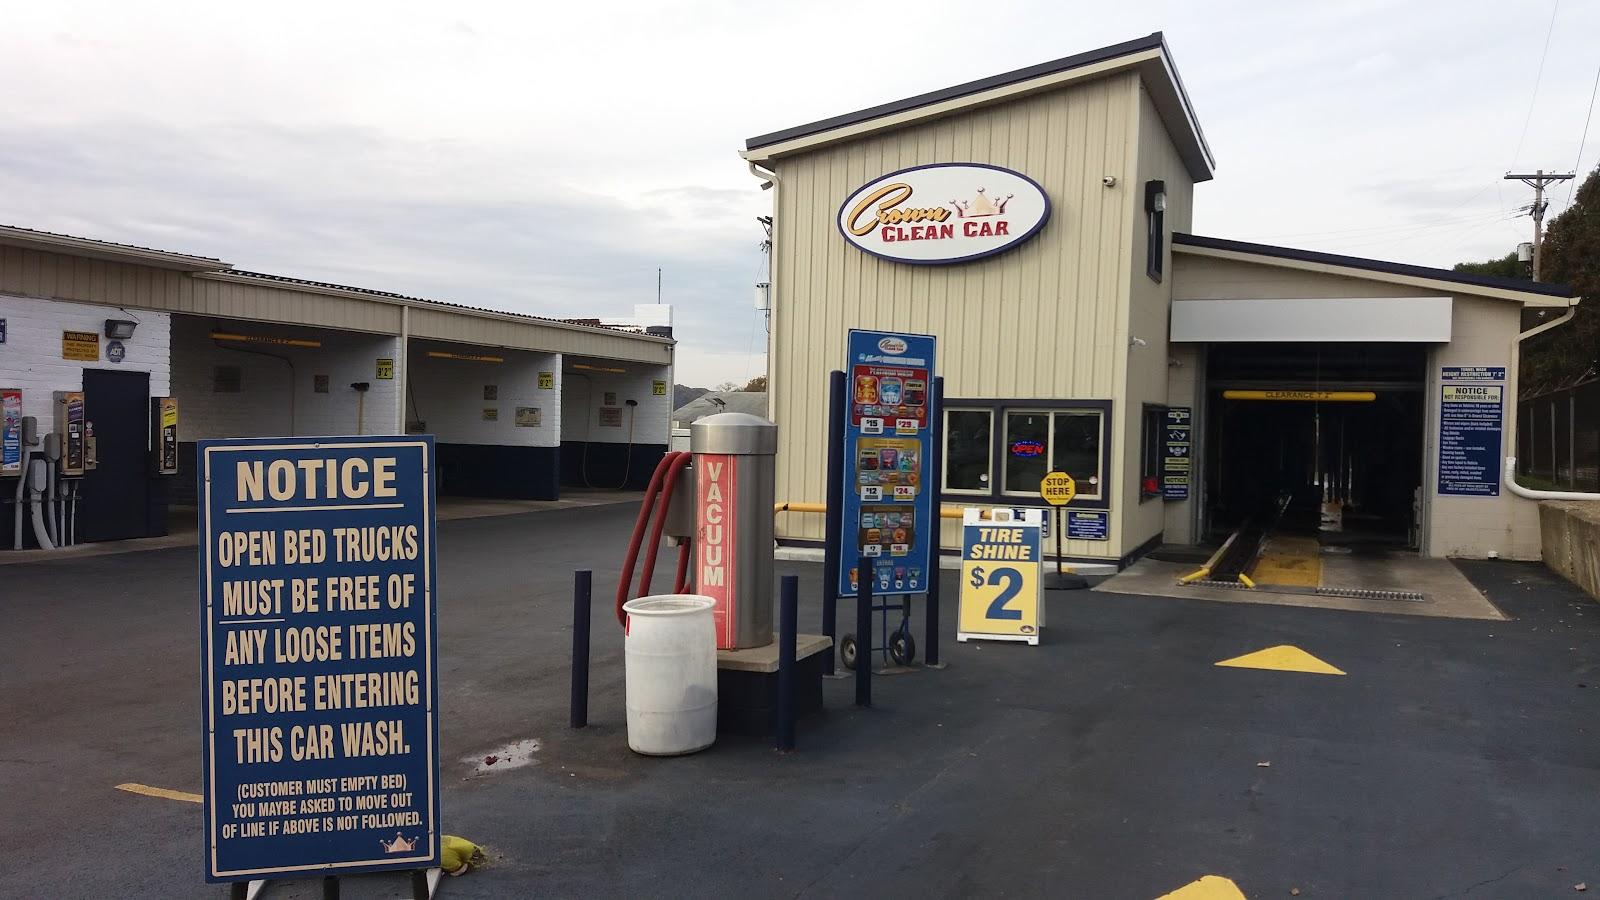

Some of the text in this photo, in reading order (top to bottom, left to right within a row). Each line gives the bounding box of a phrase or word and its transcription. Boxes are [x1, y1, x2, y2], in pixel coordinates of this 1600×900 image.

[847, 182, 952, 237] Crown
[881, 221, 1010, 242] CLEAN CAR
[66, 333, 97, 341] WARNING
[110, 347, 122, 356] ADT
[1265, 391, 1314, 399] CLEARANCE
[1455, 387, 1488, 395] NOTICE
[1011, 444, 1044, 454] OPEN
[237, 457, 397, 502] NOTICE
[1046, 477, 1070, 486] STOP
[1046, 487, 1070, 496] HERE
[703, 462, 724, 587] VACUUM
[979, 528, 1024, 543] TIRE
[218, 525, 418, 567] OPEN BED TRUCKS
[970, 545, 1032, 560] SHINE
[223, 573, 415, 616] MUST BE FREE OF
[225, 622, 416, 666] ANY LOOSE ITEMS
[222, 670, 419, 716] BEFORE ENTERING
[233, 720, 411, 764] THIS CAR WASH.
[237, 774, 407, 801] (CUSTOMER MUST EMPTY BED)
[232, 793, 413, 819] YOU MAYBE ASKED TO MOVE OUT
[222, 811, 423, 839] OF LINE IF ABOVE IS NOT FOLLOWED.
